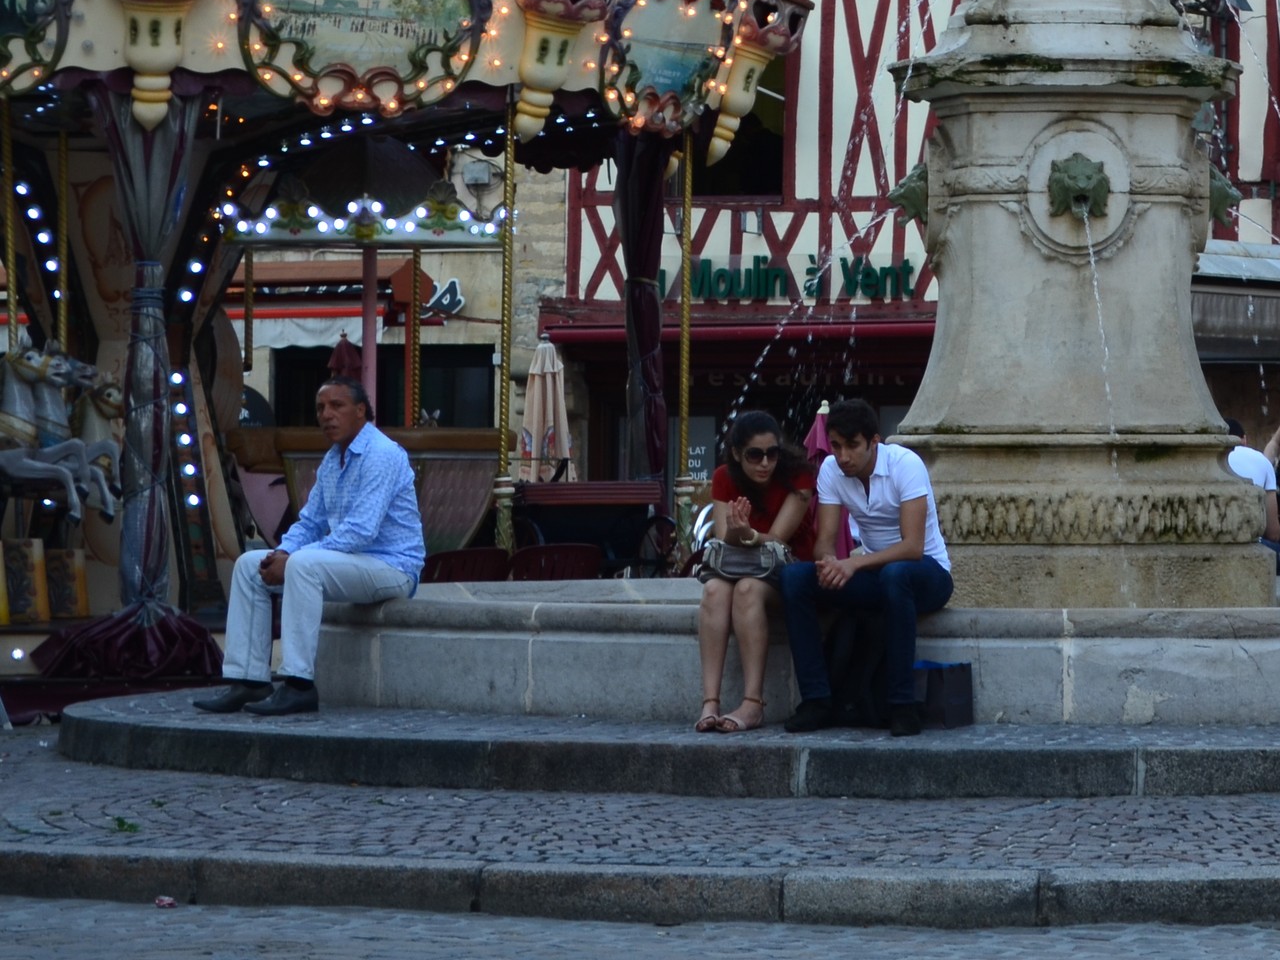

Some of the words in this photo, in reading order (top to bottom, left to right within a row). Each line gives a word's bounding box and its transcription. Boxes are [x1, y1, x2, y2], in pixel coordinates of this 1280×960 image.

[690, 255, 787, 298] Moulin
[804, 254, 823, 297] à
[839, 256, 914, 298] Vent
[687, 446, 706, 455] LAT
[688, 460, 701, 468] DU
